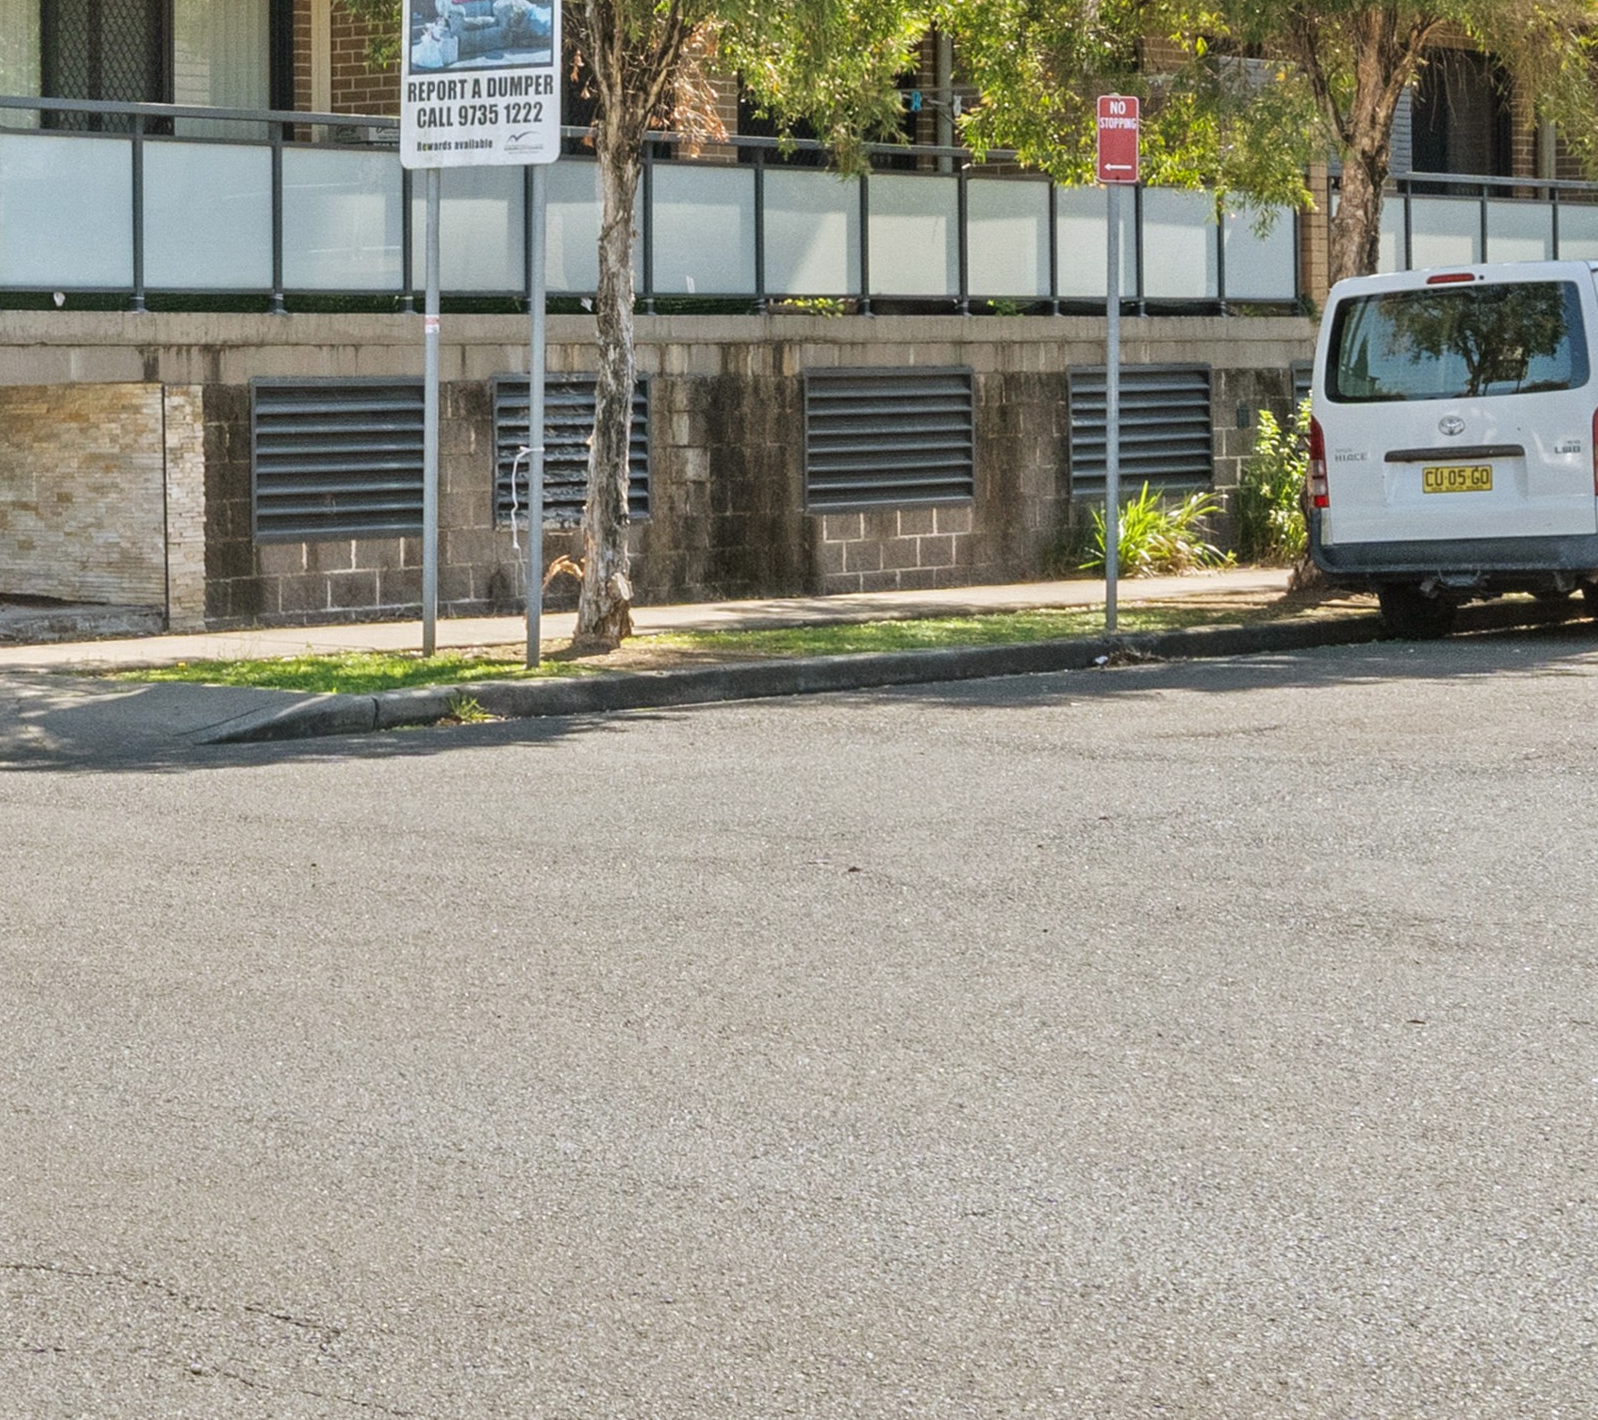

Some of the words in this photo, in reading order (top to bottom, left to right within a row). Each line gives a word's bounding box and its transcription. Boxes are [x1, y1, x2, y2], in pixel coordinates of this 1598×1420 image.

[408, 79, 466, 103] REPORT
[471, 78, 482, 99] A
[487, 74, 554, 98] DUMPER
[1109, 101, 1126, 115] NO
[417, 107, 453, 129] CALL
[458, 104, 498, 127] 9735
[504, 102, 543, 124] 1222
[1100, 117, 1137, 129] STOPPING
[417, 140, 452, 151] Rewards
[454, 138, 493, 150] available
